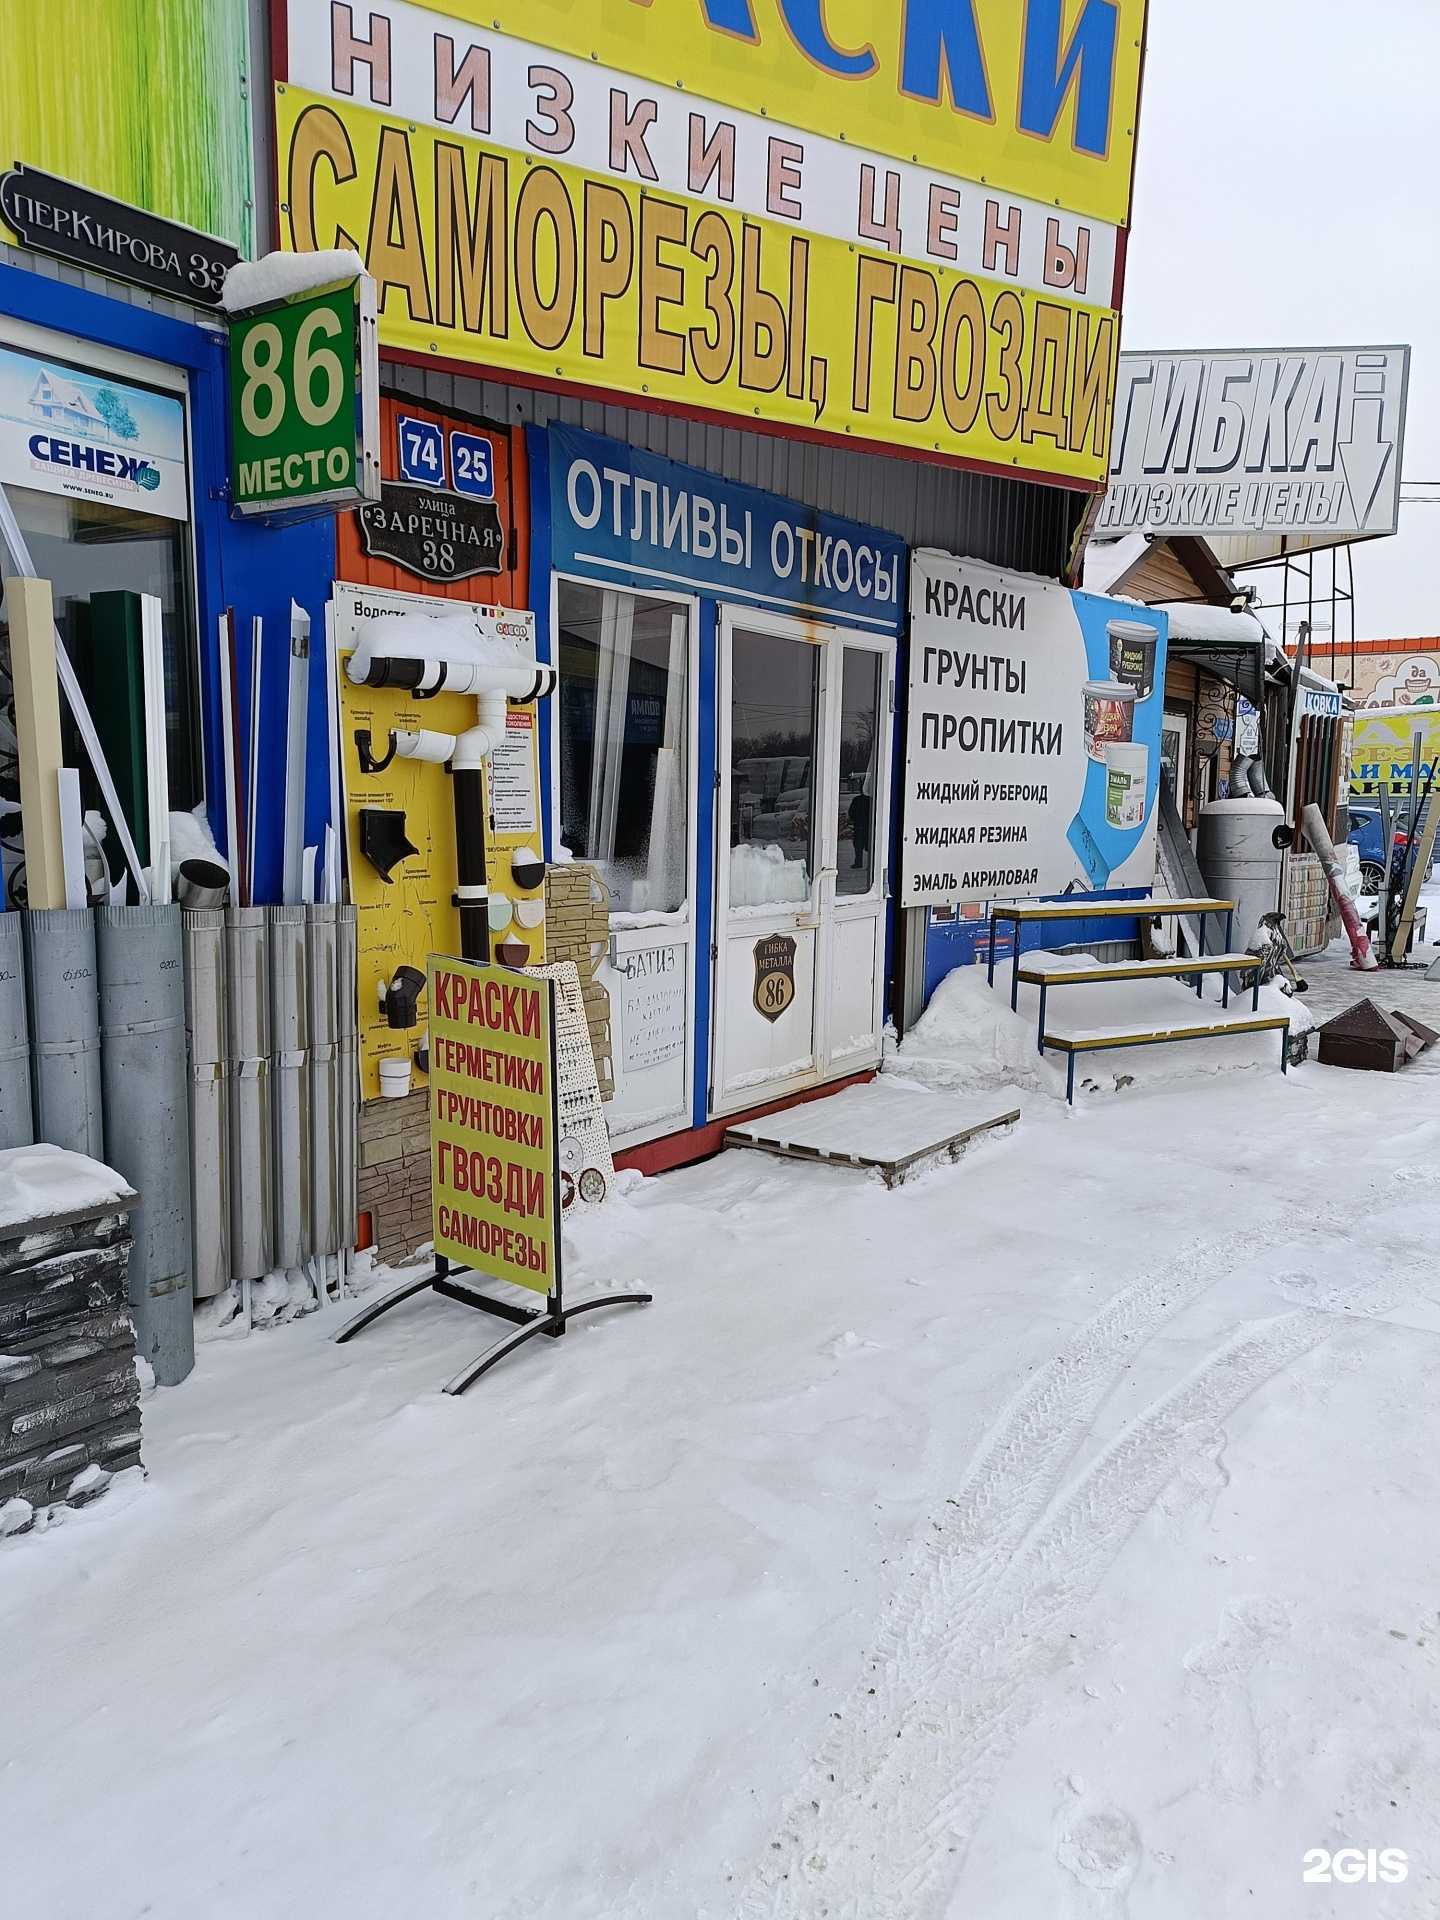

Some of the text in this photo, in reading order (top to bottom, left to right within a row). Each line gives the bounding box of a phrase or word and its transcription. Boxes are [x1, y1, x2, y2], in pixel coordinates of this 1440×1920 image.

[331, 0, 1090, 294] НИЗКИЕ ЦЕНЫ
[287, 104, 1112, 457] САМОРЕЗЫ, ГВОЗДИ
[241, 307, 344, 437] 86
[1111, 356, 1345, 475] ГИБКА
[29, 434, 149, 480] СЕНЕЖ
[239, 447, 350, 495] МЕСТО
[406, 433, 438, 471] 74
[456, 447, 488, 483] 25
[371, 506, 495, 548] ЗАРЕЧНАЯ
[1100, 481, 1345, 530] НИЗКИЕ ЦЕНЫ
[567, 458, 898, 604] ОТЛИВЫ ОТКОСЫ
[422, 540, 455, 572] 38
[924, 576, 1026, 631] КРАСКИ
[922, 647, 1027, 694] ГРУНТЫ
[1306, 693, 1338, 716] КОВКА
[921, 713, 1063, 756] ПРОПИТКИ
[917, 779, 1048, 804] ЖИДКИЙ РУБЕРОИД
[915, 825, 1028, 848] ЖИДКАЯ РЕЗИНА
[913, 868, 1038, 892] ЭМАЛЬ АКРИЛОВАЯ
[764, 942, 788, 954] ГИБКА
[435, 970, 541, 1040] КРАСКИ
[766, 977, 784, 1007] 86
[435, 1037, 543, 1095] ГЕРМЕТИКИ
[437, 1089, 543, 1150] ГРУНТОВКИ
[438, 1141, 545, 1220] ГВОЗДИ
[438, 1205, 547, 1274] САМОРЕЗЫ
